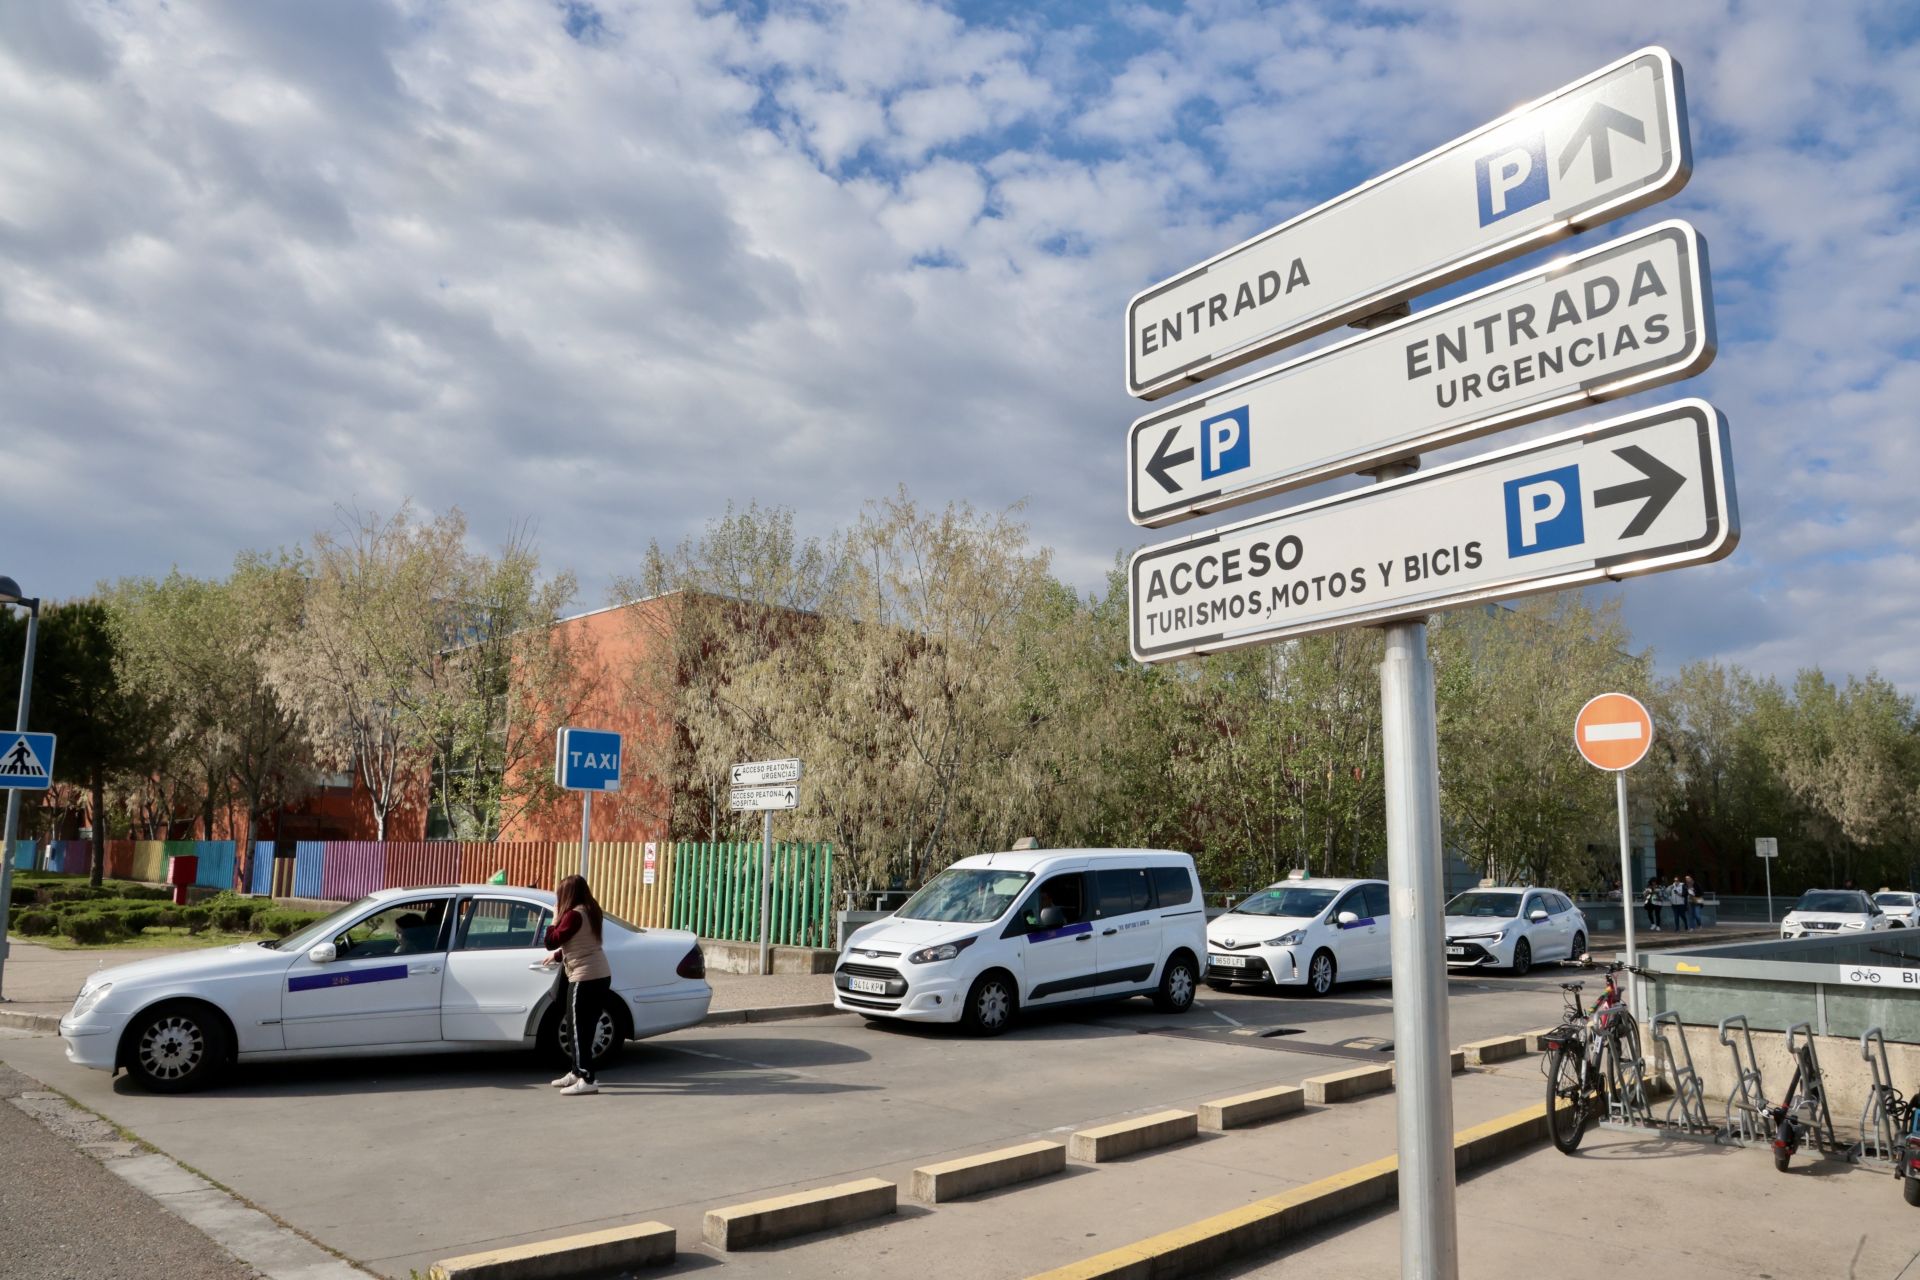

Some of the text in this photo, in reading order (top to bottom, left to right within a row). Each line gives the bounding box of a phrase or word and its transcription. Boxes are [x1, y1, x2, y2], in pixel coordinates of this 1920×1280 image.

[1488, 148, 1533, 216] P
[1141, 257, 1310, 357] ENTRADA
[1405, 259, 1667, 381] ENTRADA
[1436, 313, 1670, 409] URGENCIAS
[1209, 417, 1240, 472] P
[1518, 480, 1566, 547] P
[1146, 534, 1304, 603] ACCESO
[1378, 560, 1394, 587] Y
[1404, 541, 1483, 583] BICIS
[570, 751, 617, 770] TAXI
[742, 762, 796, 774] ACCESO PEATONAL
[761, 770, 796, 780] URGENCIAS
[732, 790, 785, 800] ACCESO PEATONAL
[732, 799, 759, 807] HOSPITAL
[1902, 971, 1920, 984] BI
